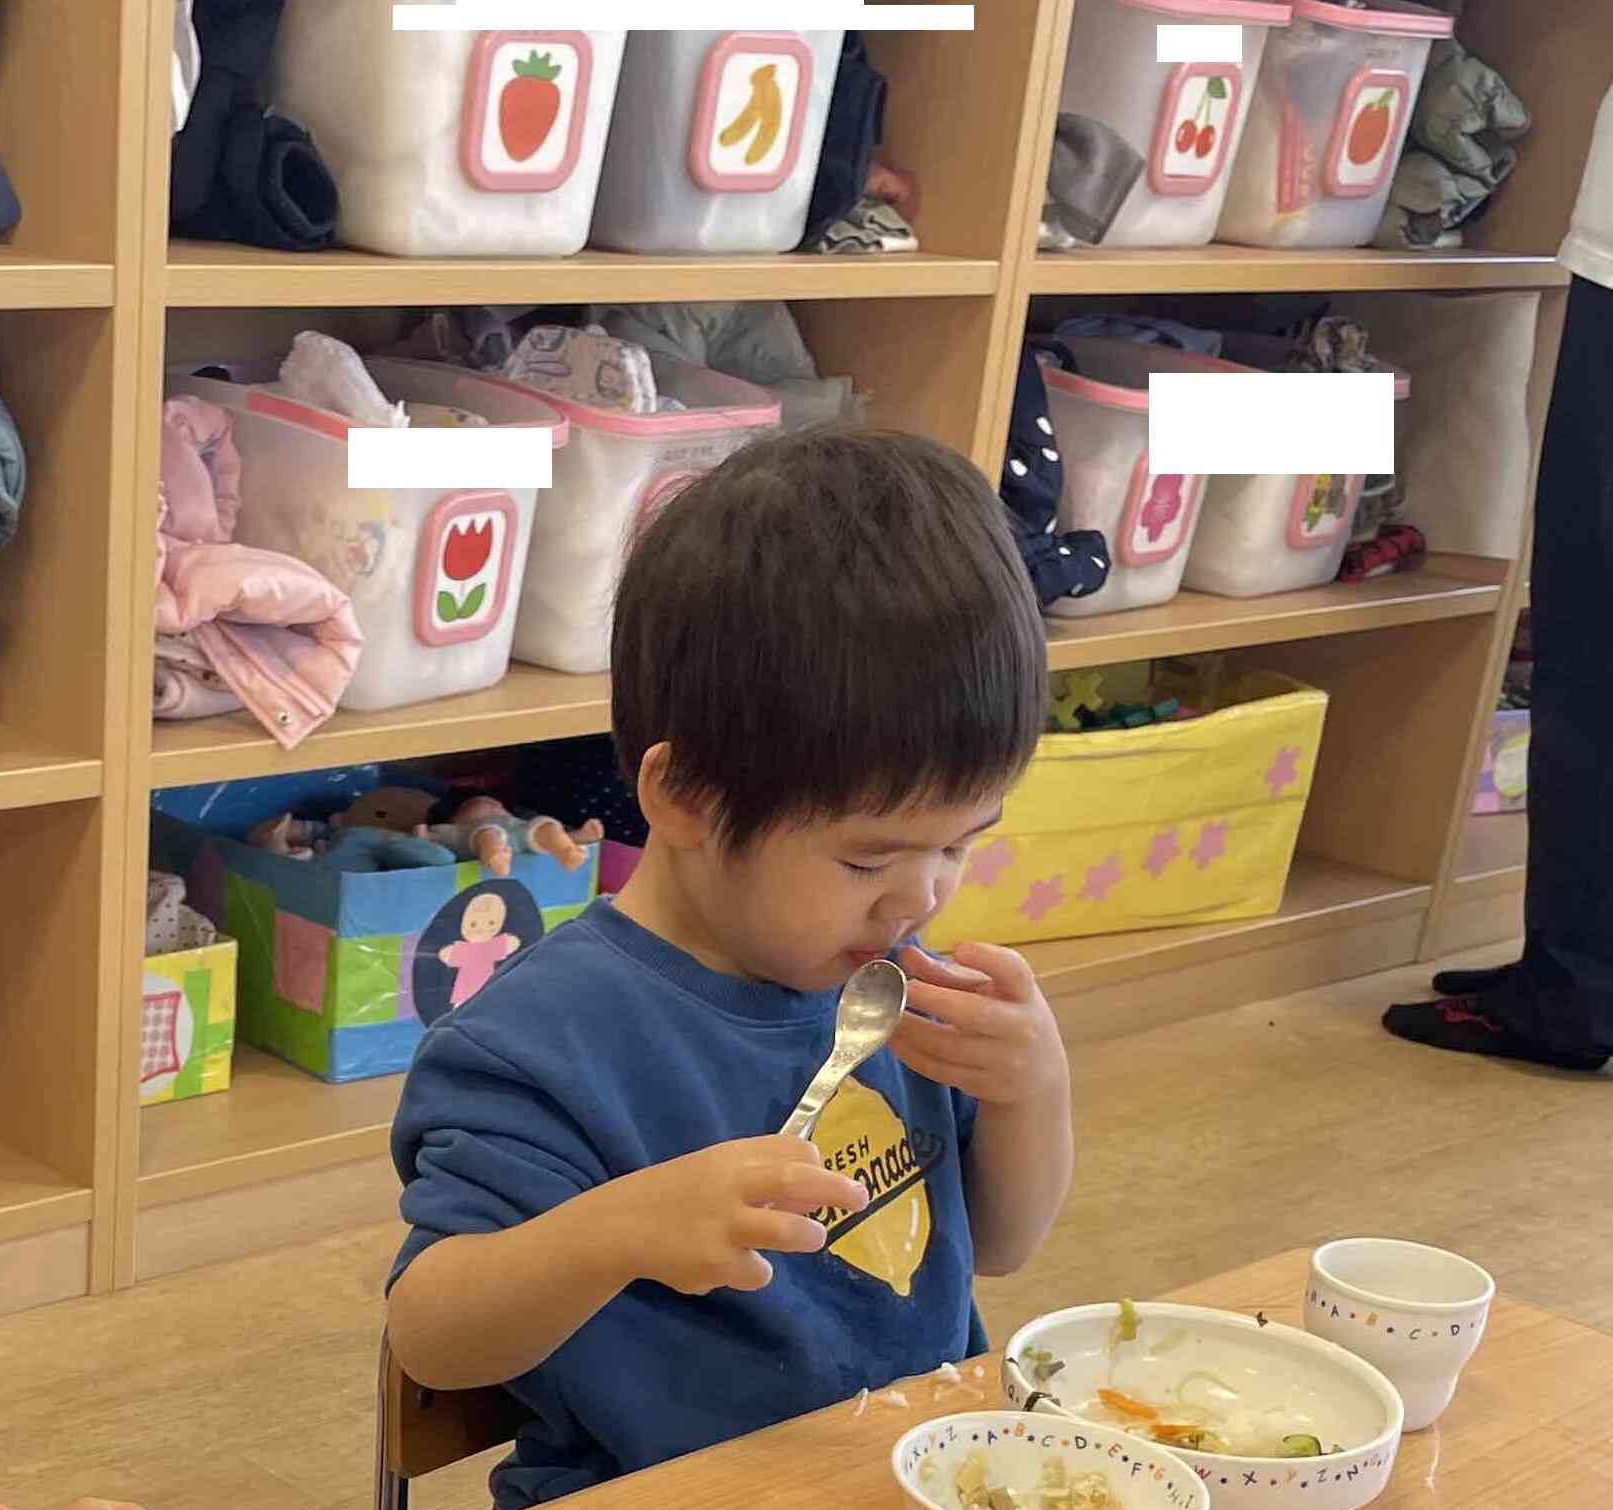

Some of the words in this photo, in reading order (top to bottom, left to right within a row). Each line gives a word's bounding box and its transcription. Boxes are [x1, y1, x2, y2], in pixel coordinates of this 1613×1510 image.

[824, 1135, 871, 1171] RESH
[1074, 1434, 1088, 1450] D
[1107, 1442, 1124, 1458] E
[1131, 1461, 1144, 1477] F
